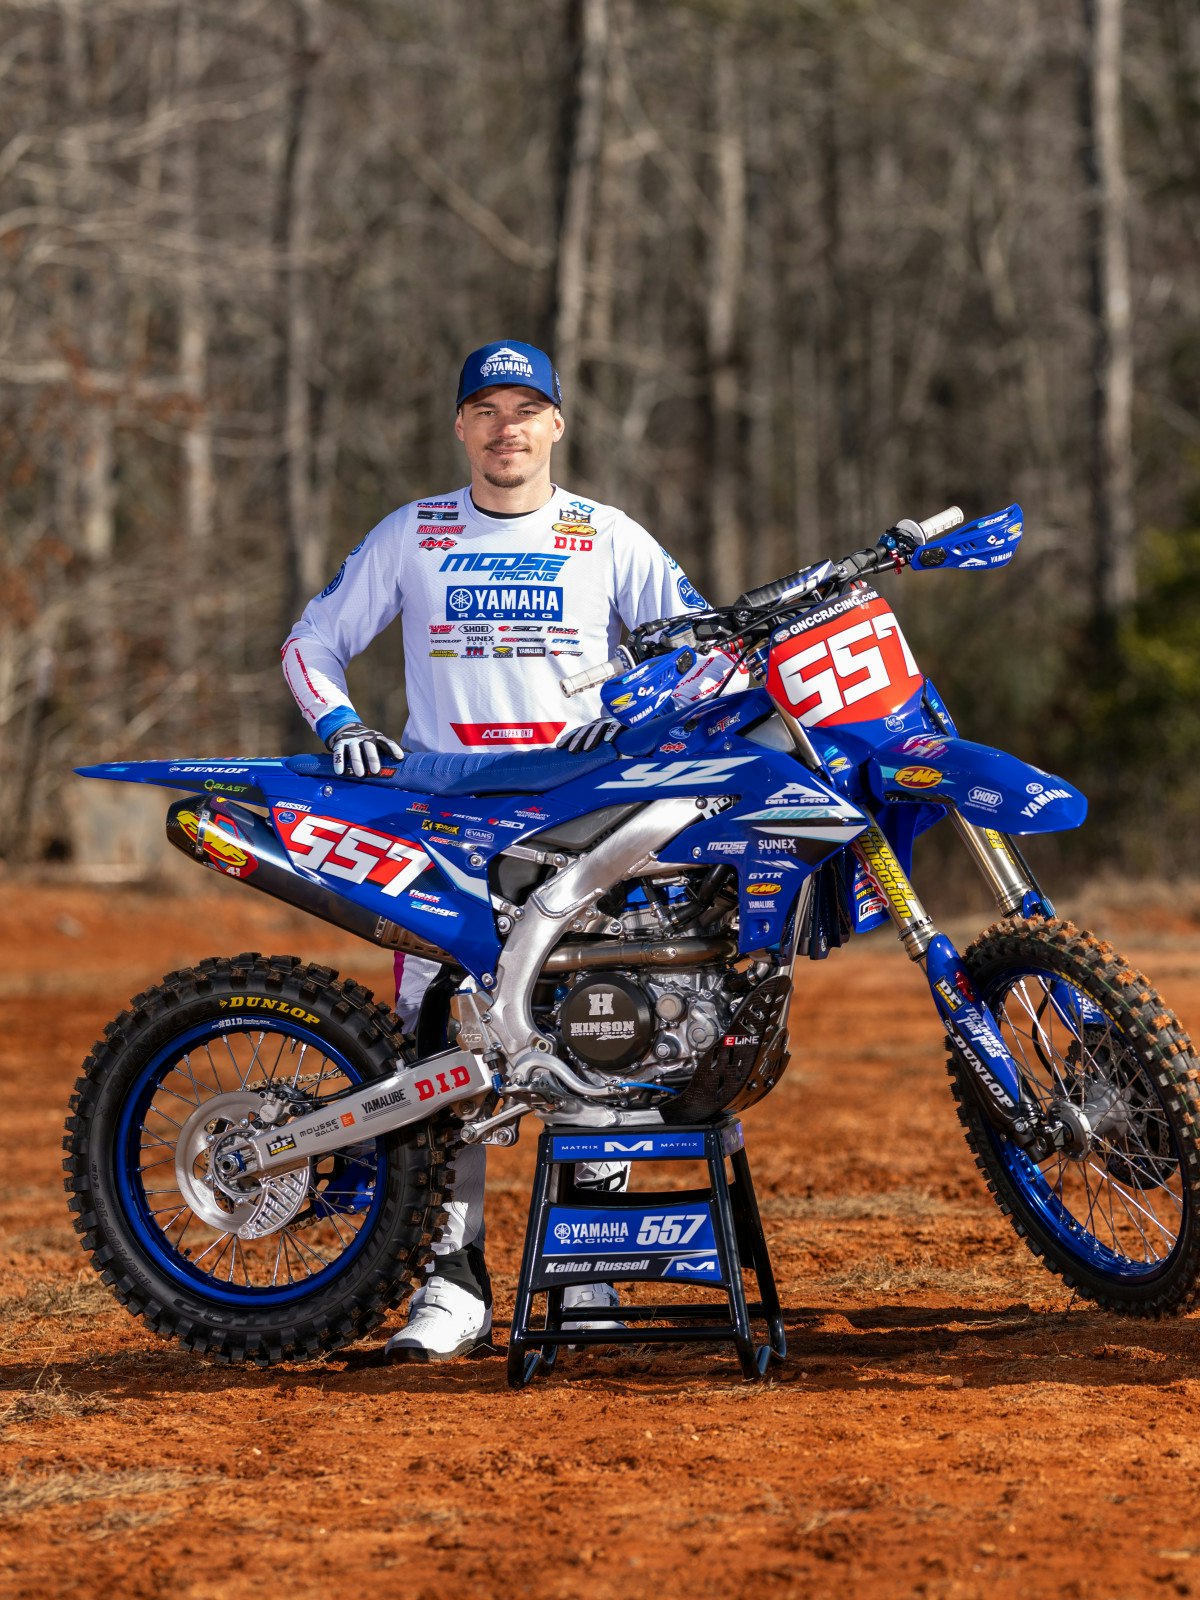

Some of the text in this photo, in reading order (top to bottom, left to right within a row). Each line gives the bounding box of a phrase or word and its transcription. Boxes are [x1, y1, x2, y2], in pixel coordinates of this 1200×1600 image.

[492, 361, 534, 375] YAMAHA
[553, 524, 597, 535] FMF
[418, 539, 457, 549] IMS
[439, 552, 572, 573] MOOSE
[990, 551, 1013, 564] YAMAHA
[488, 571, 559, 582] RACING
[475, 589, 559, 611] YAMAHA
[789, 590, 879, 636] GNCCRACING.COM
[463, 625, 489, 633] SHOEI
[465, 646, 485, 656] TM
[777, 611, 921, 728] 557
[629, 705, 654, 725] YAMAHA
[660, 743, 686, 752] IMS
[181, 765, 250, 774] DUNLOP
[895, 769, 943, 784] FMF
[971, 788, 1000, 805] SHOEI
[274, 800, 312, 813] RUSSELL
[411, 802, 429, 812] TM
[1020, 789, 1073, 819] YAMAHA
[498, 819, 525, 830] SIDI
[467, 829, 493, 840] EVANS
[706, 840, 749, 851] MOOSE
[758, 838, 797, 850] SUNEX
[287, 815, 433, 898] 557
[748, 872, 783, 880] GYTR
[859, 834, 912, 919] nnection
[748, 884, 782, 895] FMF
[749, 900, 775, 909] YAMALUBE
[228, 995, 321, 1025] DUNLOP
[588, 993, 614, 1016] H
[570, 1020, 635, 1034] HINSON
[952, 1033, 1015, 1109] DUNLOP
[414, 1065, 471, 1102] D.I.D
[361, 1088, 407, 1114] YAMALUBE
[299, 1118, 339, 1138] MOUSSE
[314, 1125, 340, 1138] BALLS
[268, 1135, 293, 1151] DP
[571, 1222, 629, 1238] YAMAHA
[636, 1214, 707, 1246] 557
[561, 1237, 625, 1245] RACING
[545, 1259, 650, 1274] Kailub Russell
